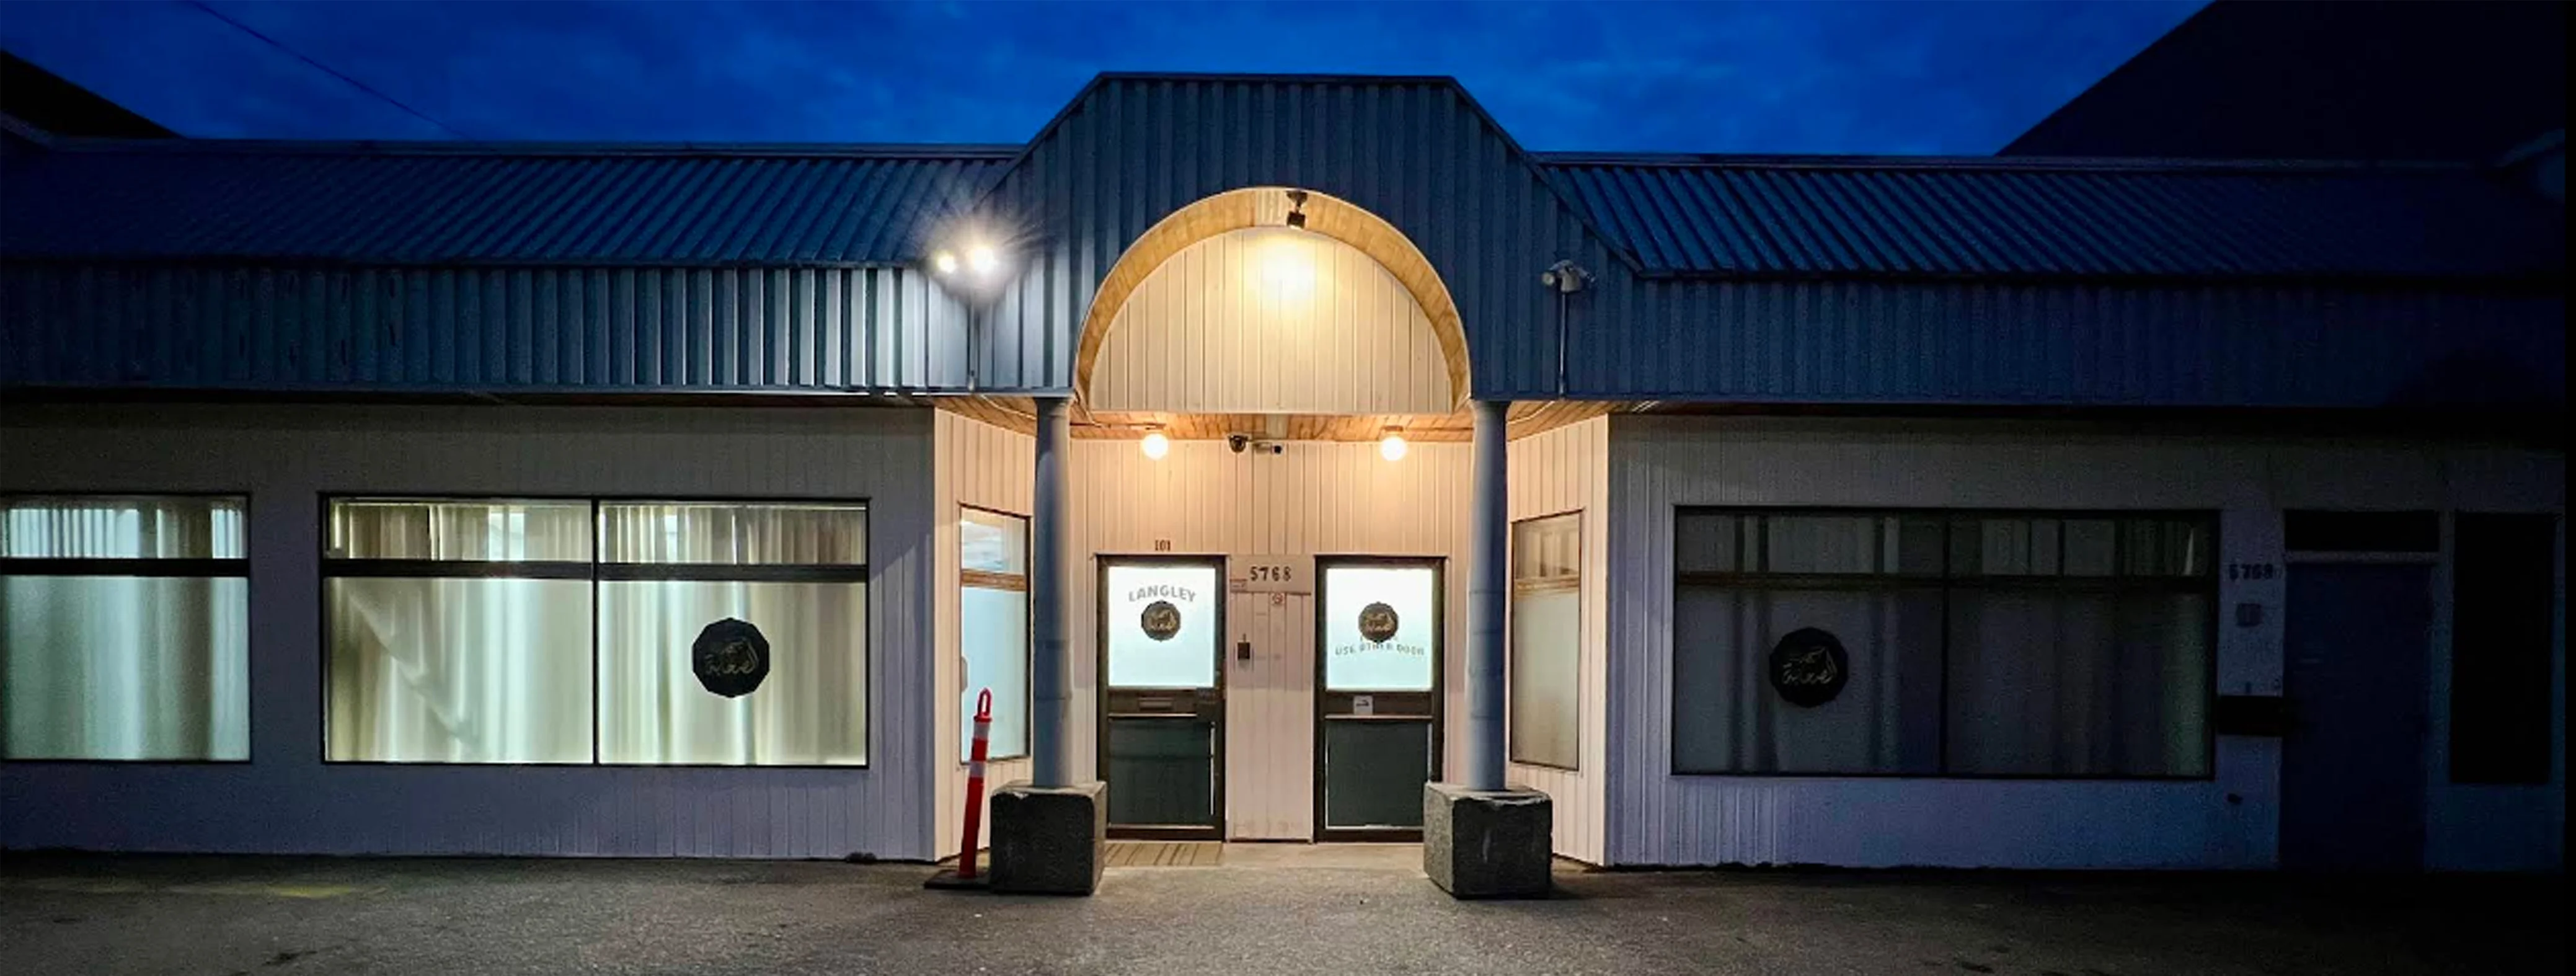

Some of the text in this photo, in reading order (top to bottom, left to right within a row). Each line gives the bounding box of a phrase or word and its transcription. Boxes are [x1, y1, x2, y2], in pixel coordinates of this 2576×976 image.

[1154, 539, 1171, 551] 101
[1250, 566, 1291, 582] 5768
[1128, 585, 1196, 602] LANGLEY
